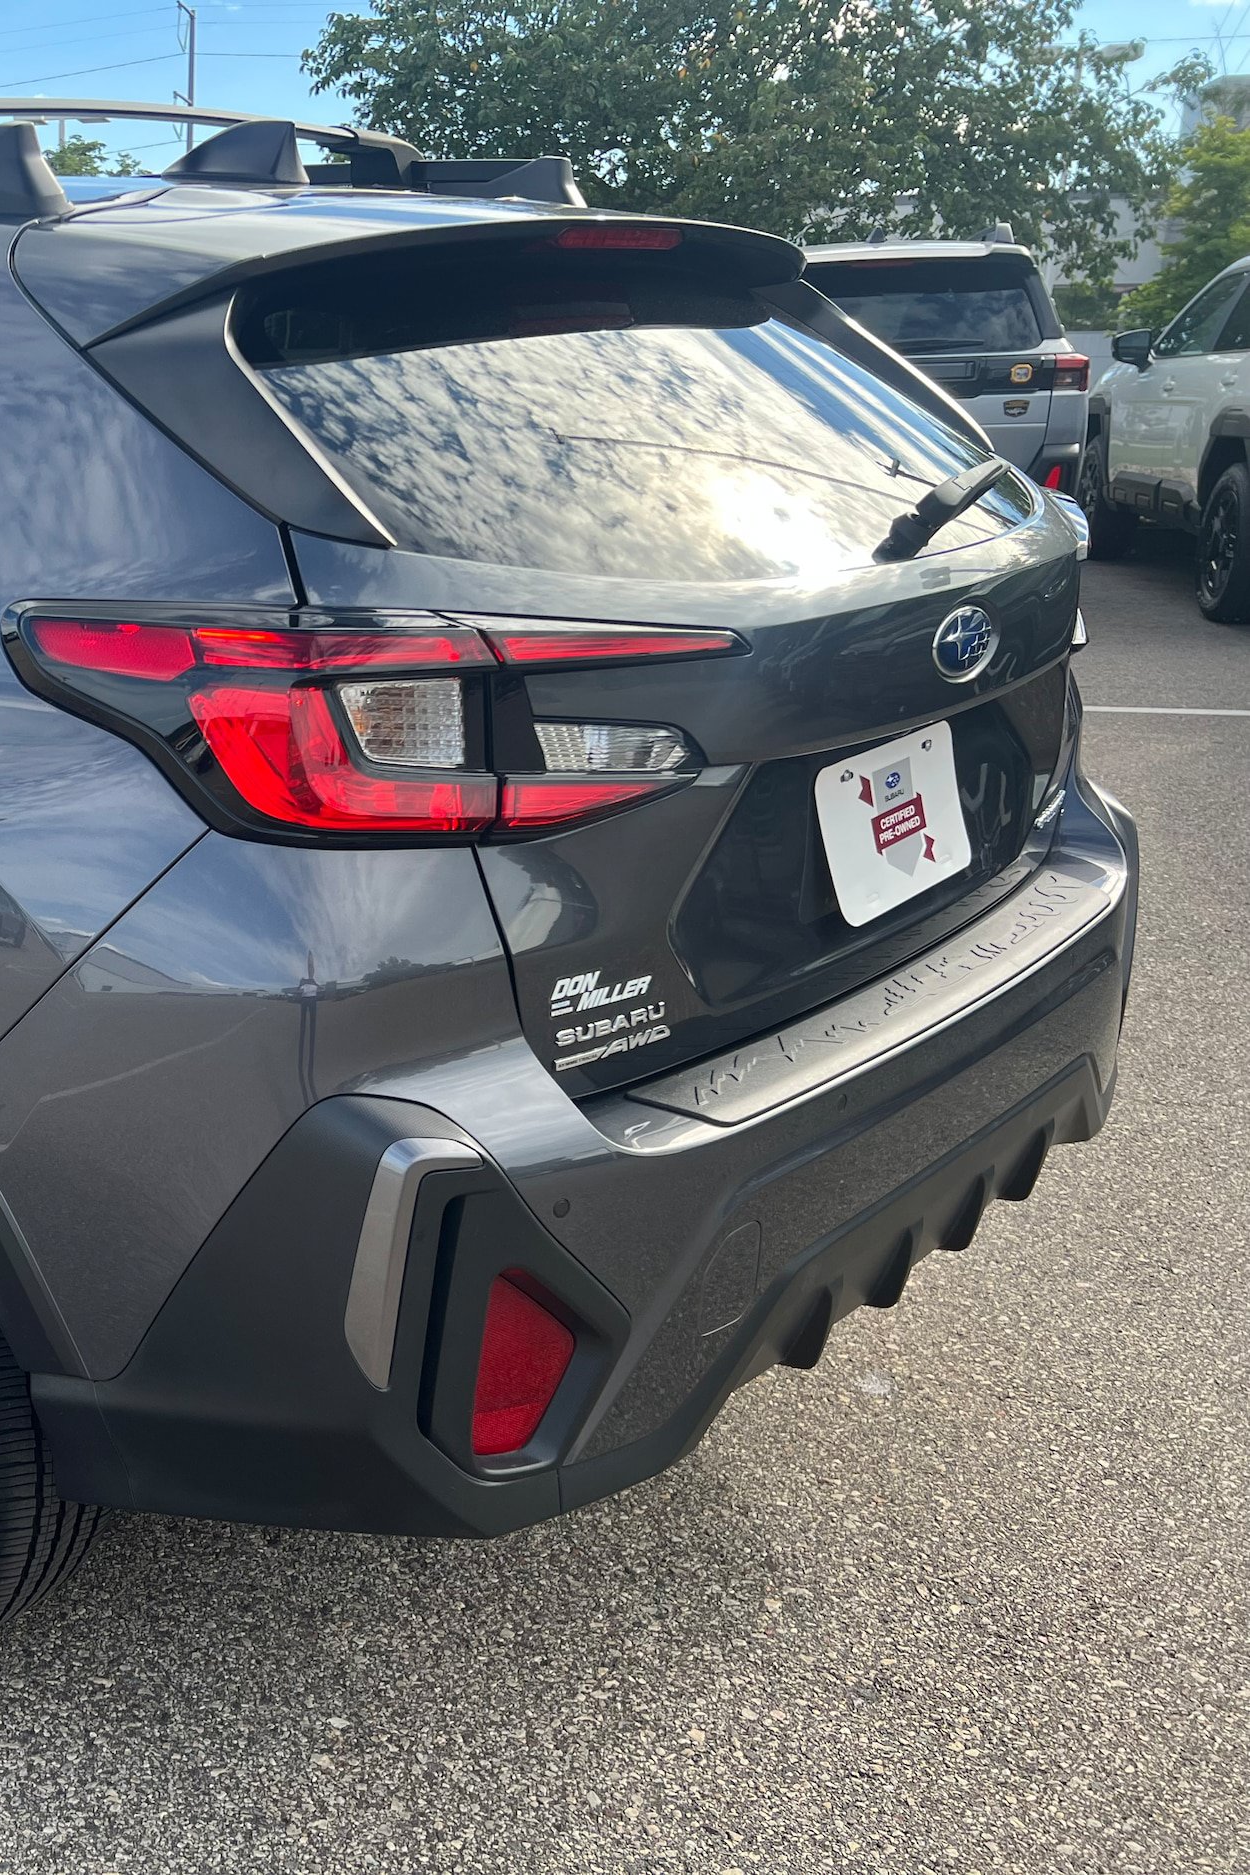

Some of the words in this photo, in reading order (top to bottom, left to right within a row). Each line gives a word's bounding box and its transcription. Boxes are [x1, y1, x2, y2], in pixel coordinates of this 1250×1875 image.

[879, 816, 921, 844] PRE-OWNED
[880, 805, 916, 830] CERTIFIED
[550, 970, 601, 1000] DON
[576, 975, 652, 1012] MILLER
[555, 1001, 665, 1047] SUBARU
[601, 1024, 670, 1059] AWD
